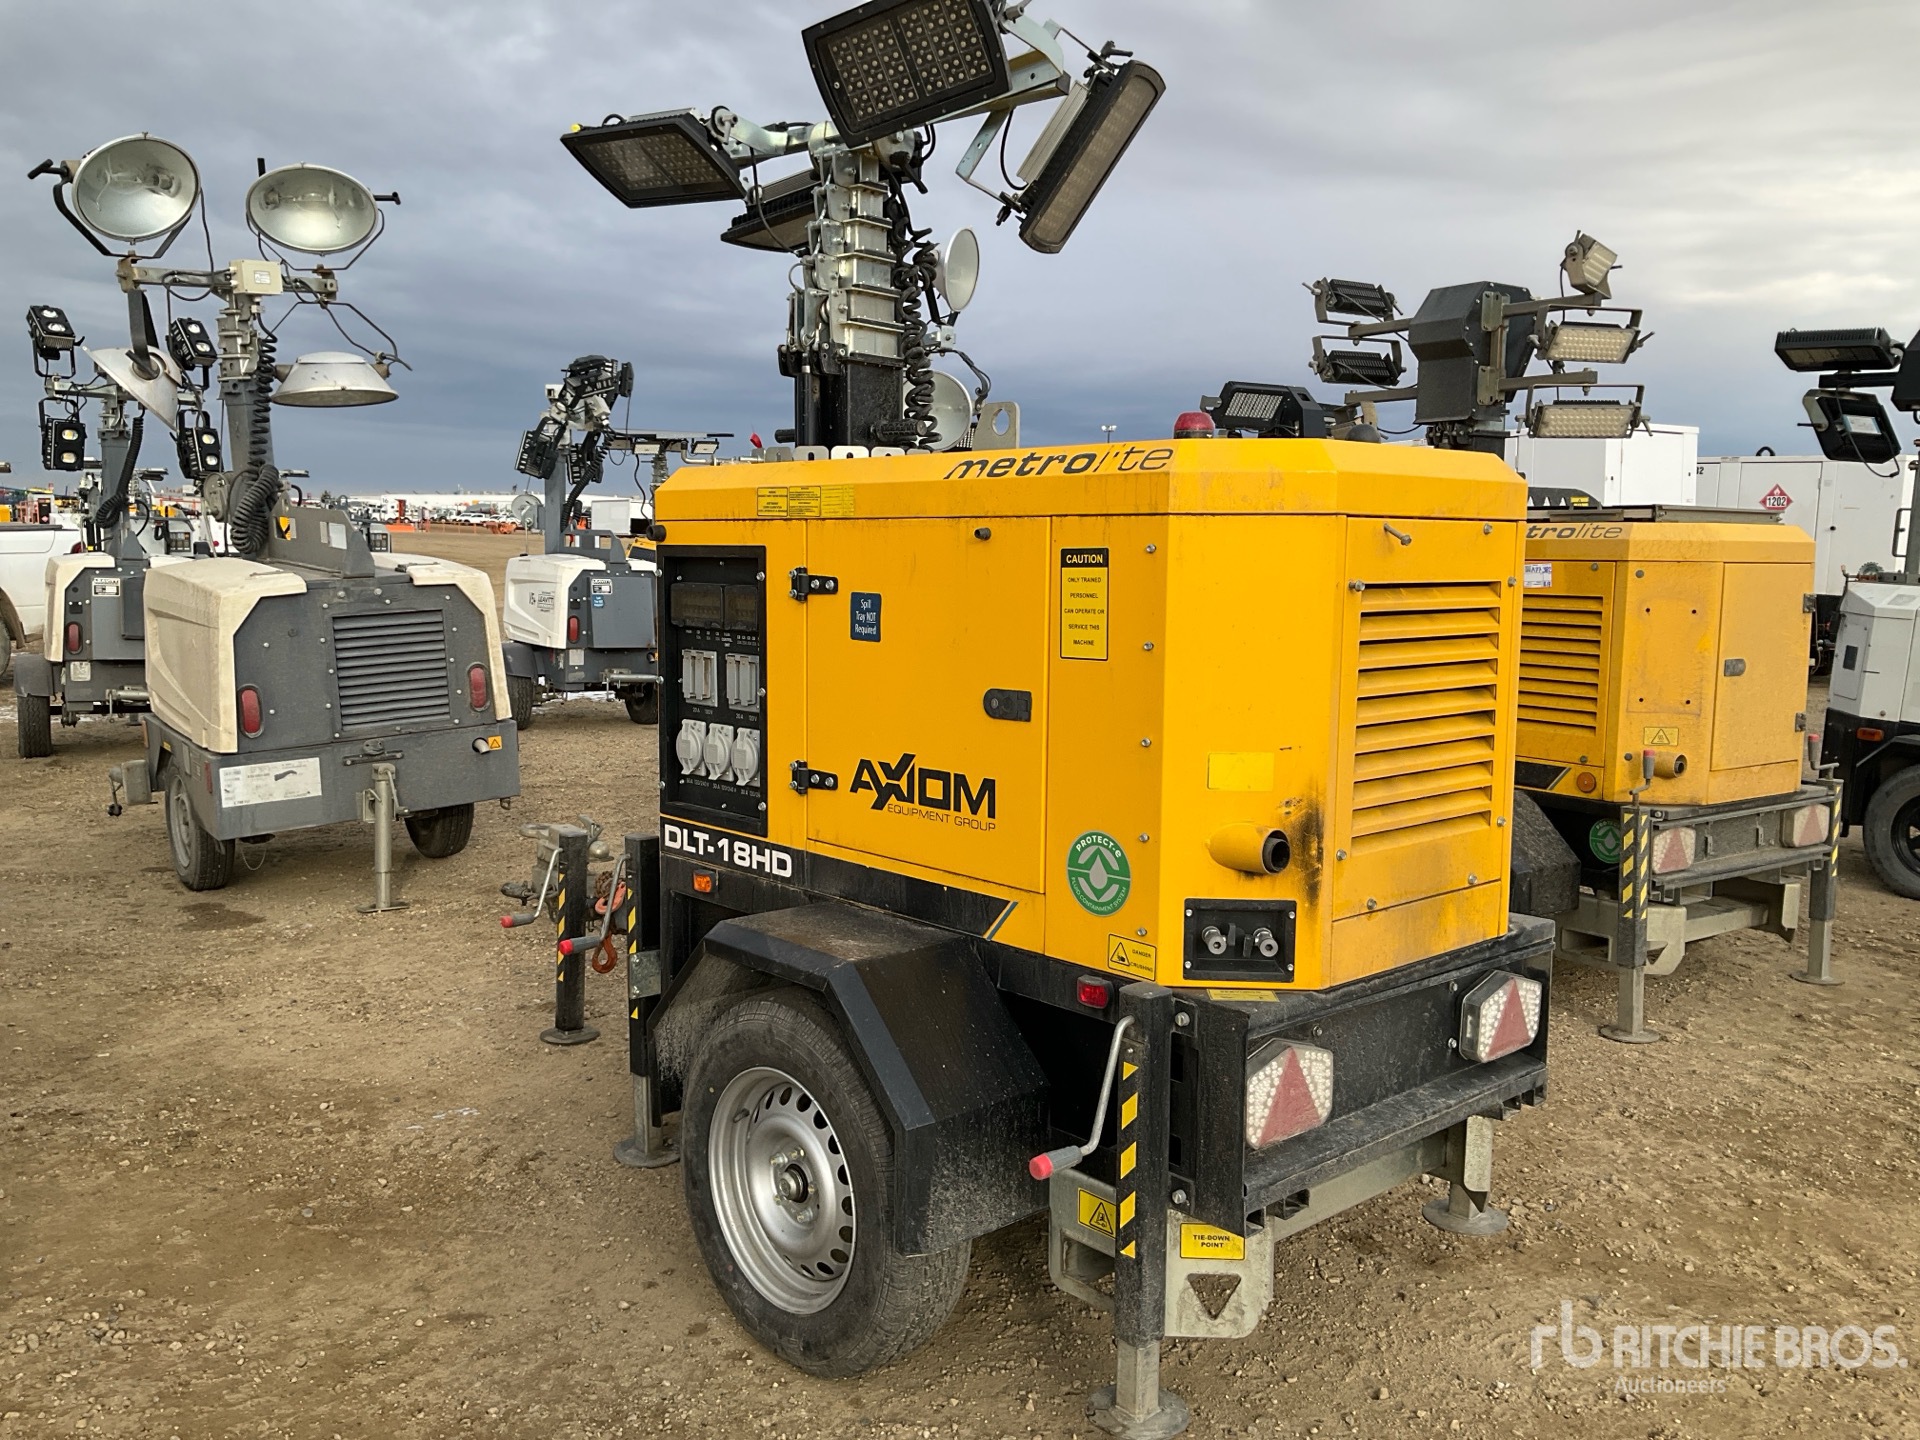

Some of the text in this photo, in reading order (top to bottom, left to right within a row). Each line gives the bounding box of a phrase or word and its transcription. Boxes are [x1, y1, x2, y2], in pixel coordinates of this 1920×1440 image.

[943, 444, 1174, 480] metrolite
[1767, 497, 1787, 506] 1202
[1526, 523, 1623, 539] trolite
[1066, 554, 1103, 564] CAUTION
[860, 599, 872, 610] Spill
[855, 611, 877, 623] Tray NOT
[854, 624, 877, 635] Required
[849, 752, 996, 820] AXIOM
[887, 803, 996, 832] EQUIPMENT GROUP
[664, 823, 793, 878] DLT-18HD
[1131, 949, 1152, 959] DANGER
[1130, 961, 1153, 973] CRUSHING
[1193, 1234, 1230, 1242] TIE-DOWN
